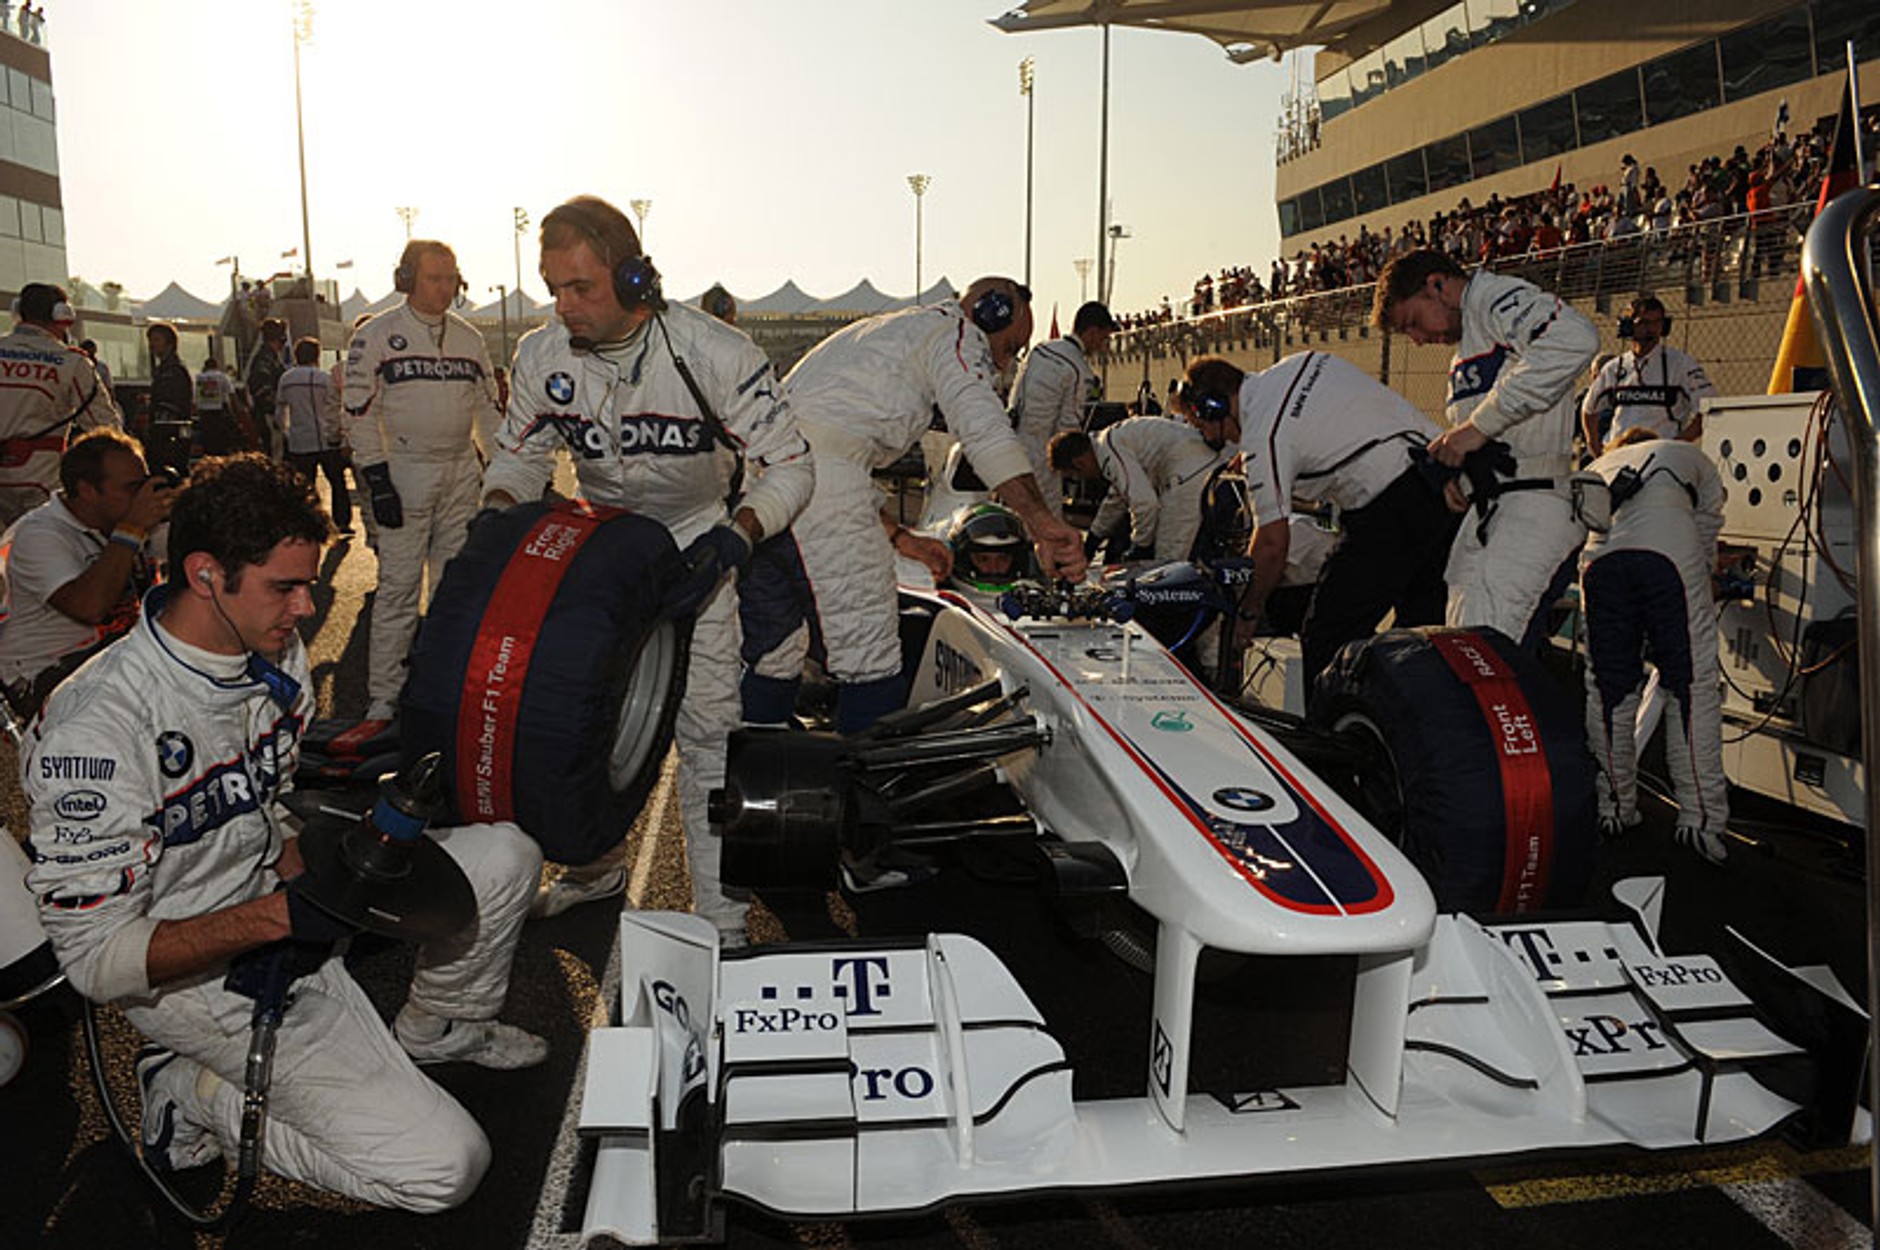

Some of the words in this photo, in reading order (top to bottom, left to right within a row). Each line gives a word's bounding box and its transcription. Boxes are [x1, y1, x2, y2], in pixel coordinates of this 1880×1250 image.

[1139, 589, 1201, 605] Systems
[487, 635, 517, 685] Team
[482, 690, 501, 711] F1
[475, 717, 498, 777] Sauber
[1492, 703, 1522, 756] Front
[1514, 713, 1538, 754] Left
[832, 957, 891, 1016] T
[1634, 963, 1724, 987] FxPro
[735, 1008, 839, 1034] FxPro
[1565, 1014, 1666, 1057] xPr
